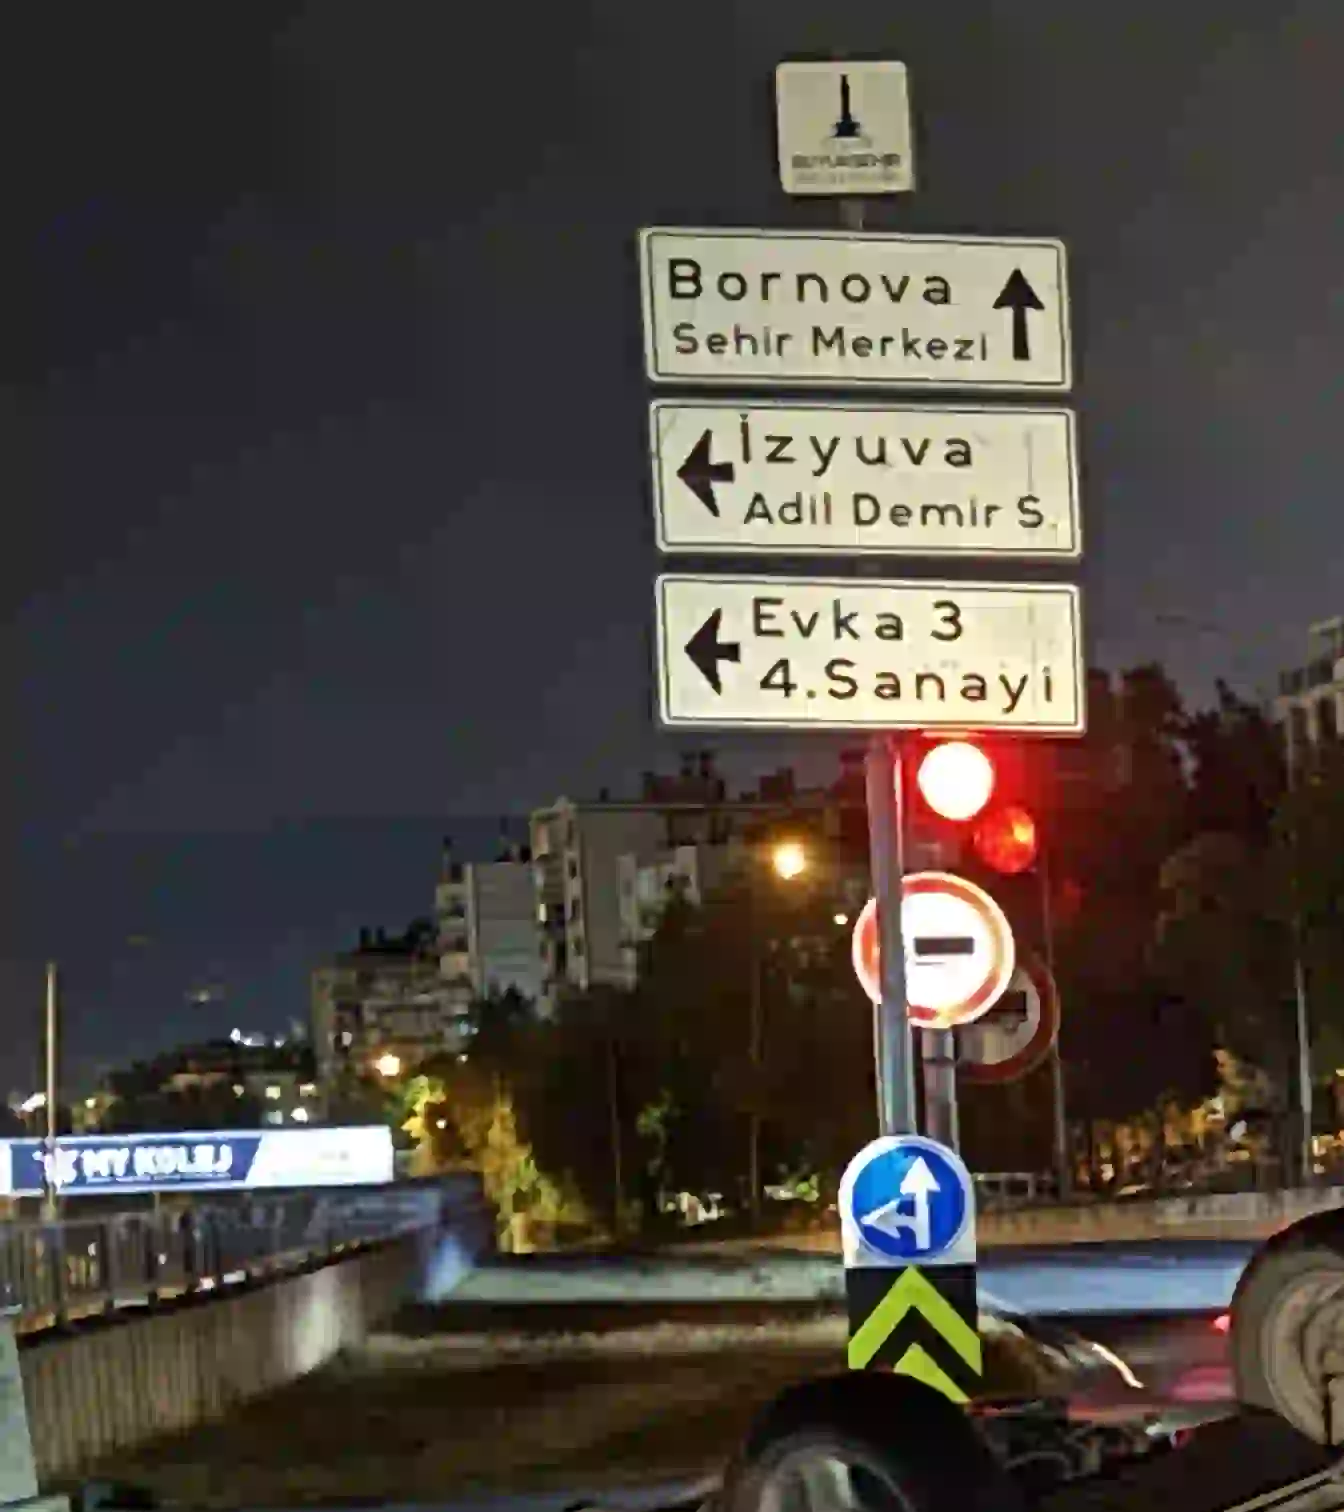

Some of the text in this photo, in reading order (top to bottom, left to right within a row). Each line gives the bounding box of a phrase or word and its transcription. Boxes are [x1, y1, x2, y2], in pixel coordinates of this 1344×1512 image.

[667, 257, 952, 305] Bornova
[811, 325, 988, 362] Merkezi
[738, 413, 973, 477] İzyuva
[742, 491, 832, 526] Adil
[852, 492, 1003, 528] Demir
[752, 596, 963, 642] Evka 3
